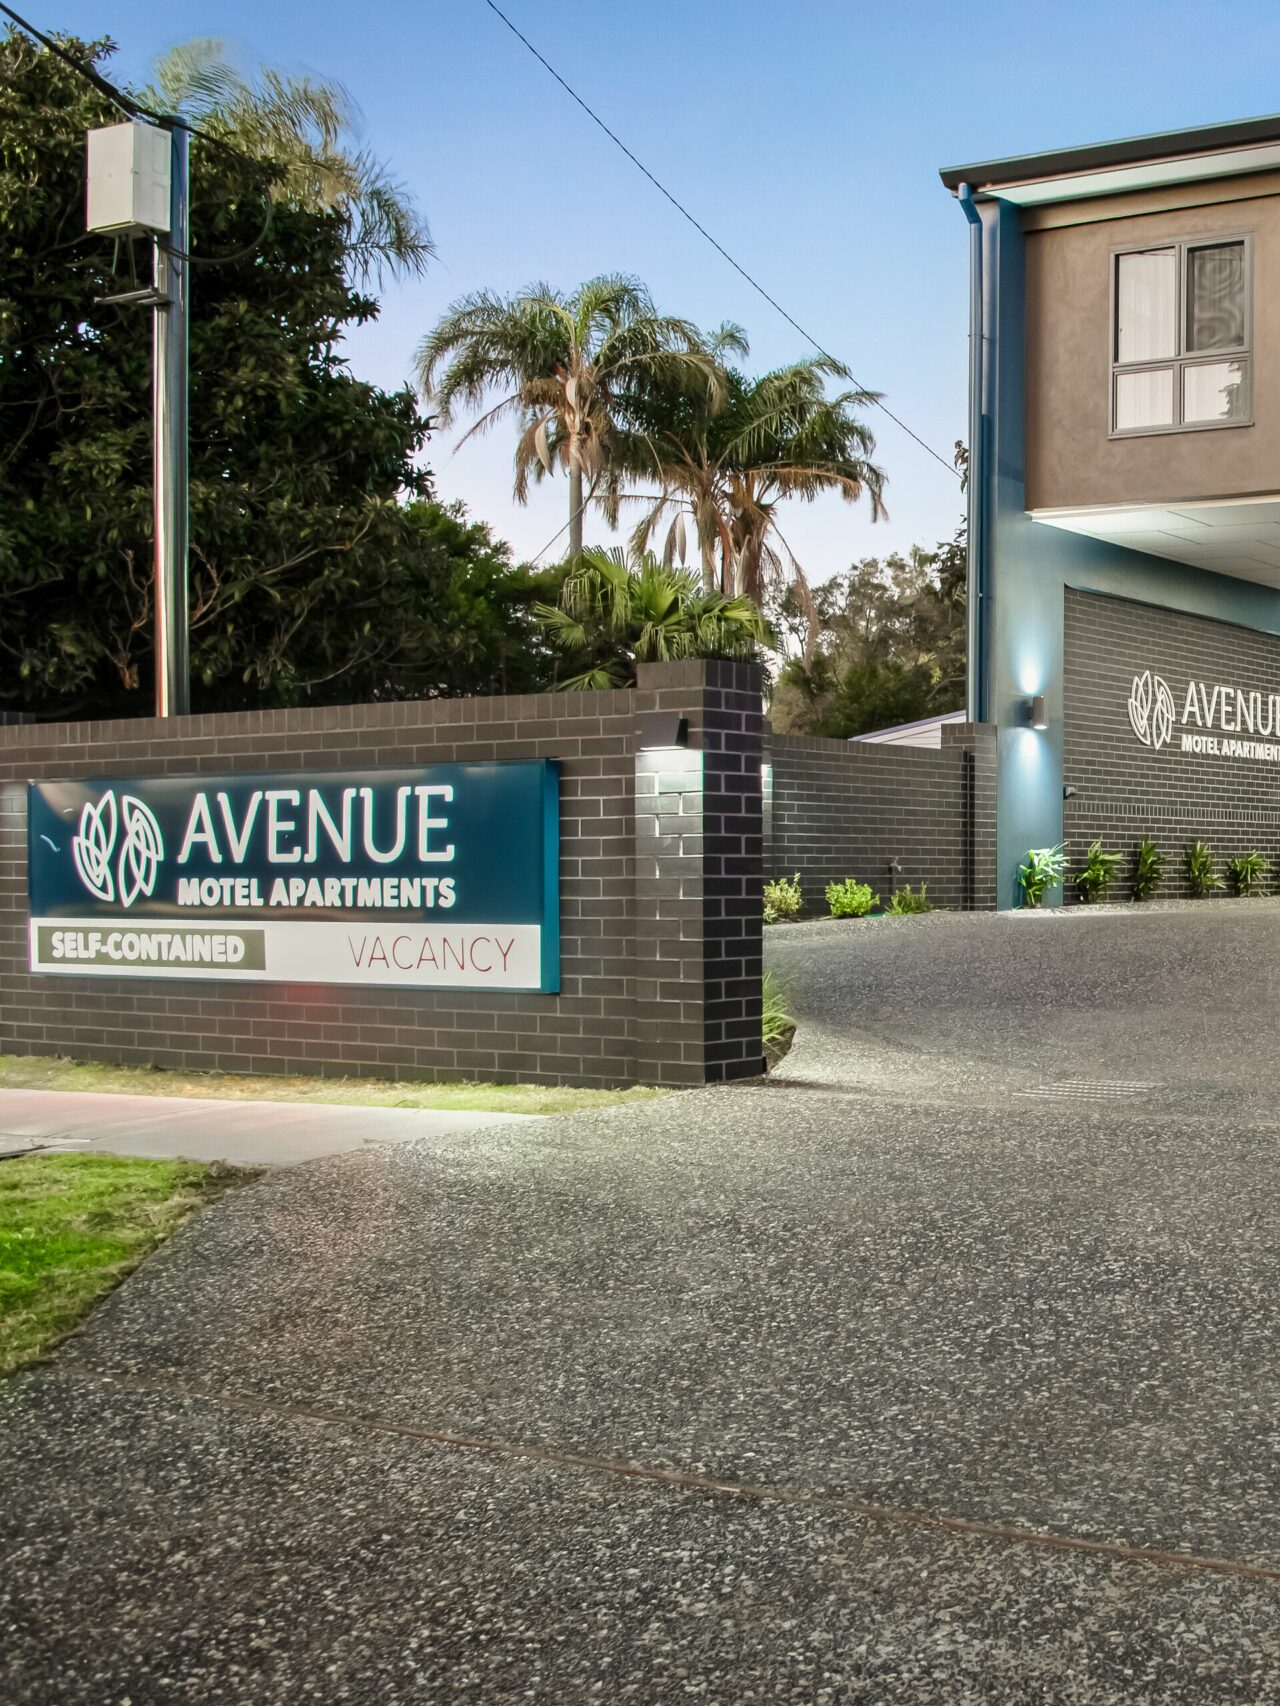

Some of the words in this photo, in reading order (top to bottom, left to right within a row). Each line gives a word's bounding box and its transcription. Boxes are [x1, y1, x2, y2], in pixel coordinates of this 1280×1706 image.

[1181, 734, 1220, 756] MOTEL
[178, 785, 456, 864] AVENUE
[177, 877, 264, 907] MOTEL
[269, 877, 456, 908] APARTMENTS
[51, 931, 246, 963] SELF-CONTAINED
[348, 935, 516, 973] VACANCY
